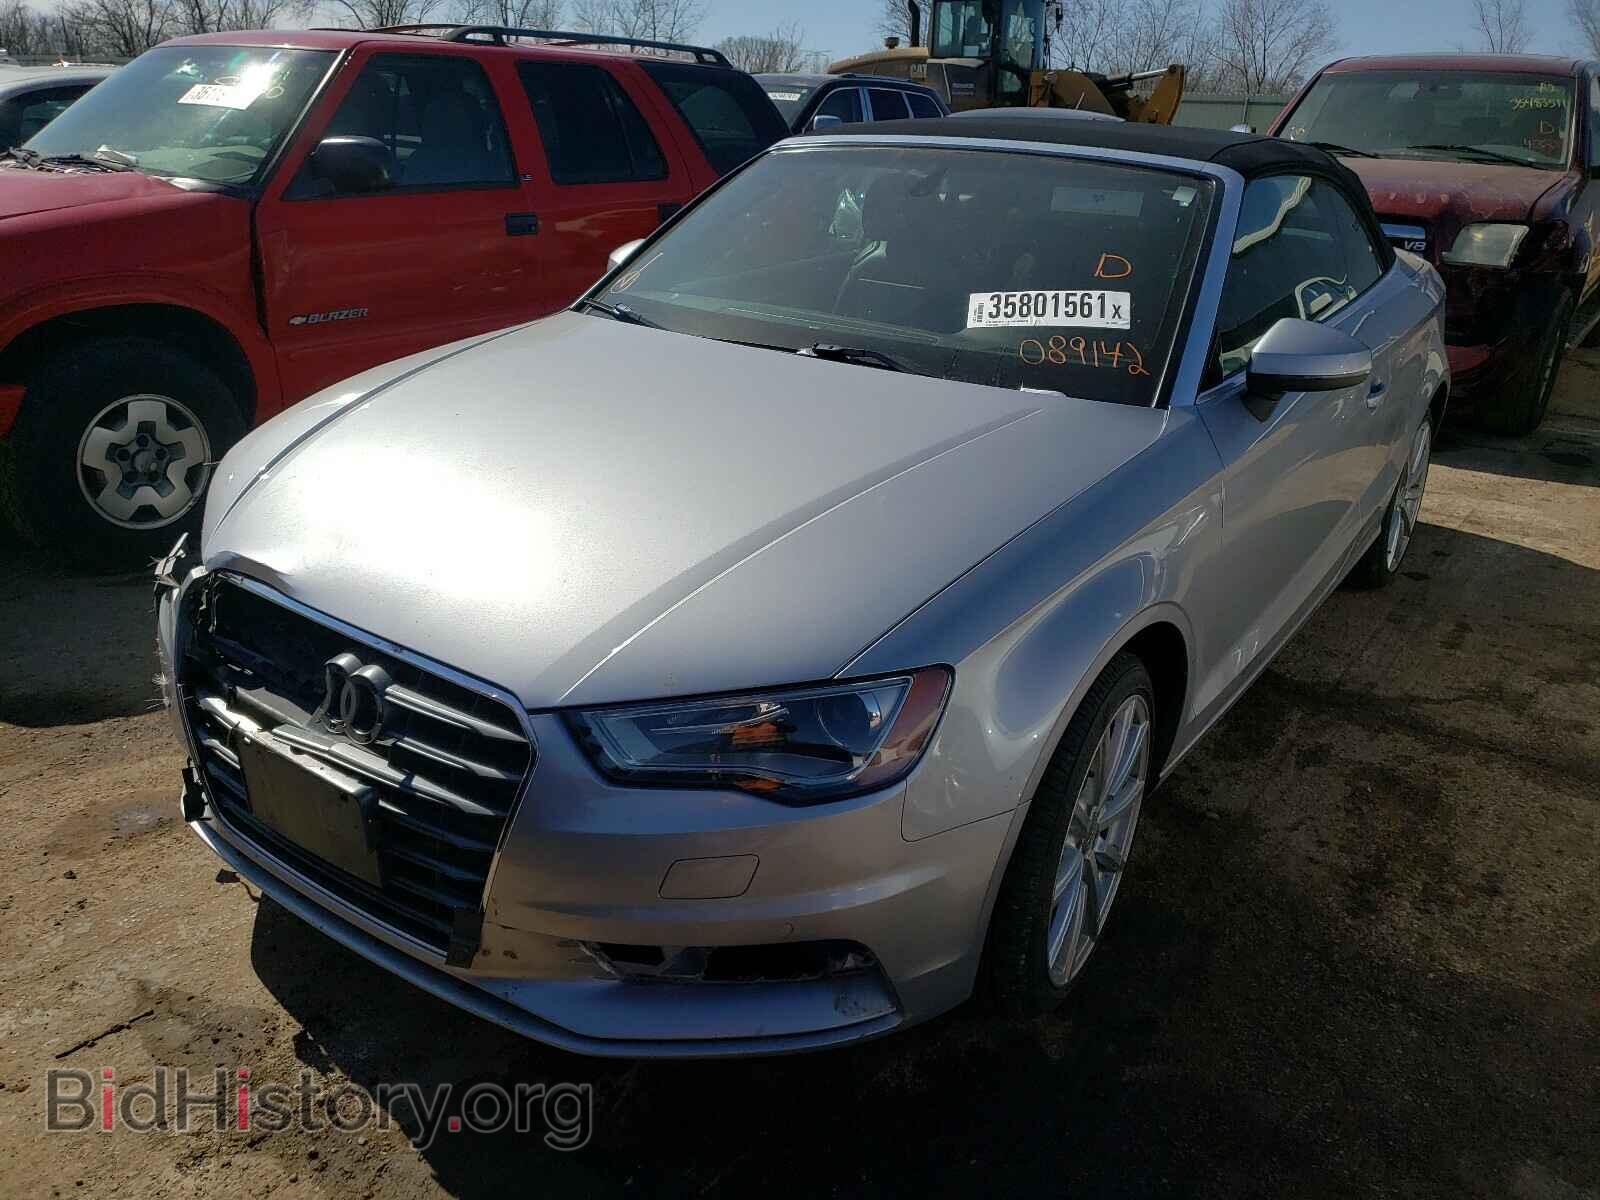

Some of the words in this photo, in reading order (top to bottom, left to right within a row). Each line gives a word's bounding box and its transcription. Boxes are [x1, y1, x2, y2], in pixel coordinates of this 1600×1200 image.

[1094, 253, 1132, 277] D
[307, 308, 369, 324] BLAZER
[988, 292, 1106, 318] 35801561
[1019, 335, 1150, 375] 089142
